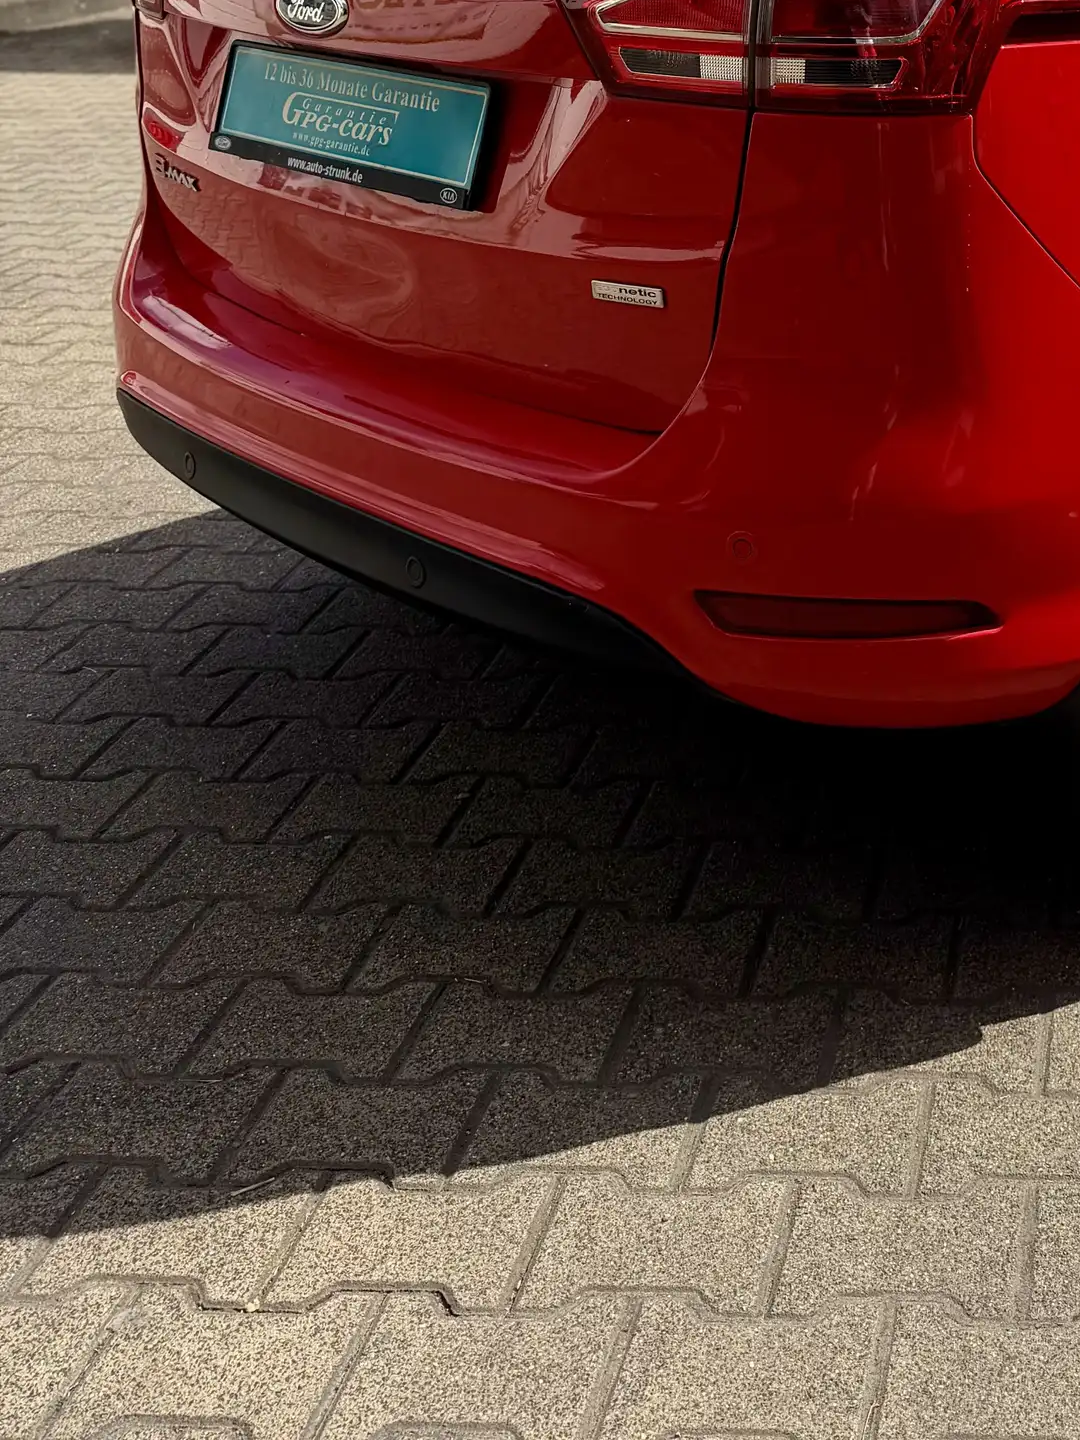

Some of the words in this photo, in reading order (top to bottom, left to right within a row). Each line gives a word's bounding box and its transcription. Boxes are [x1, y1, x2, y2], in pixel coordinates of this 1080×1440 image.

[264, 62, 277, 81] 12
[280, 64, 296, 84] bis
[300, 68, 314, 88] 36
[317, 71, 368, 98] Monate
[372, 81, 440, 112] Garantie
[302, 98, 387, 125] Garantie
[287, 156, 363, 184] www.auto-strunk.de
[442, 190, 456, 202] KIA
[596, 292, 658, 306] TECHNOLOGY
